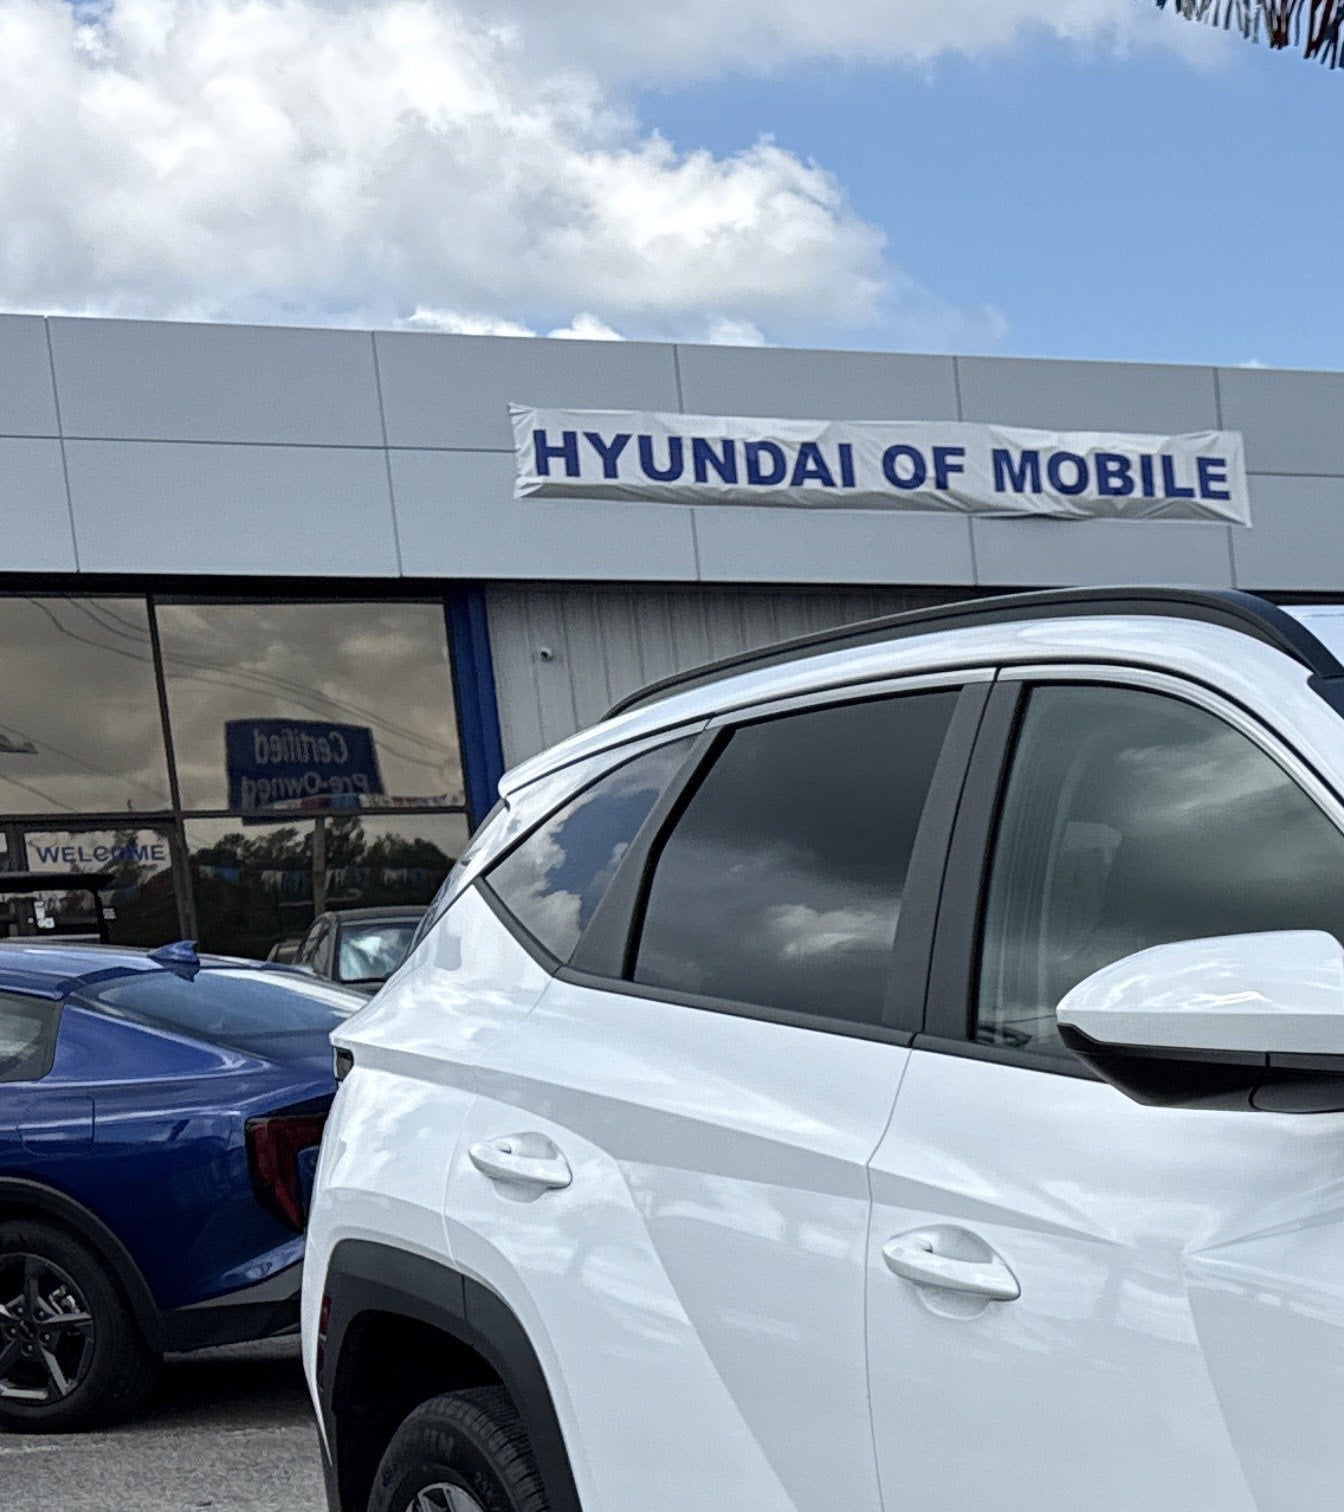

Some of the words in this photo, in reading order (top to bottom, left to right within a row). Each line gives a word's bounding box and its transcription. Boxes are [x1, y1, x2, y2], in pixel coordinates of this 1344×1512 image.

[533, 429, 856, 488] HYUNDAI
[882, 444, 965, 490] OF
[992, 447, 1231, 500] MOBILE
[36, 845, 165, 863] WELCOME
